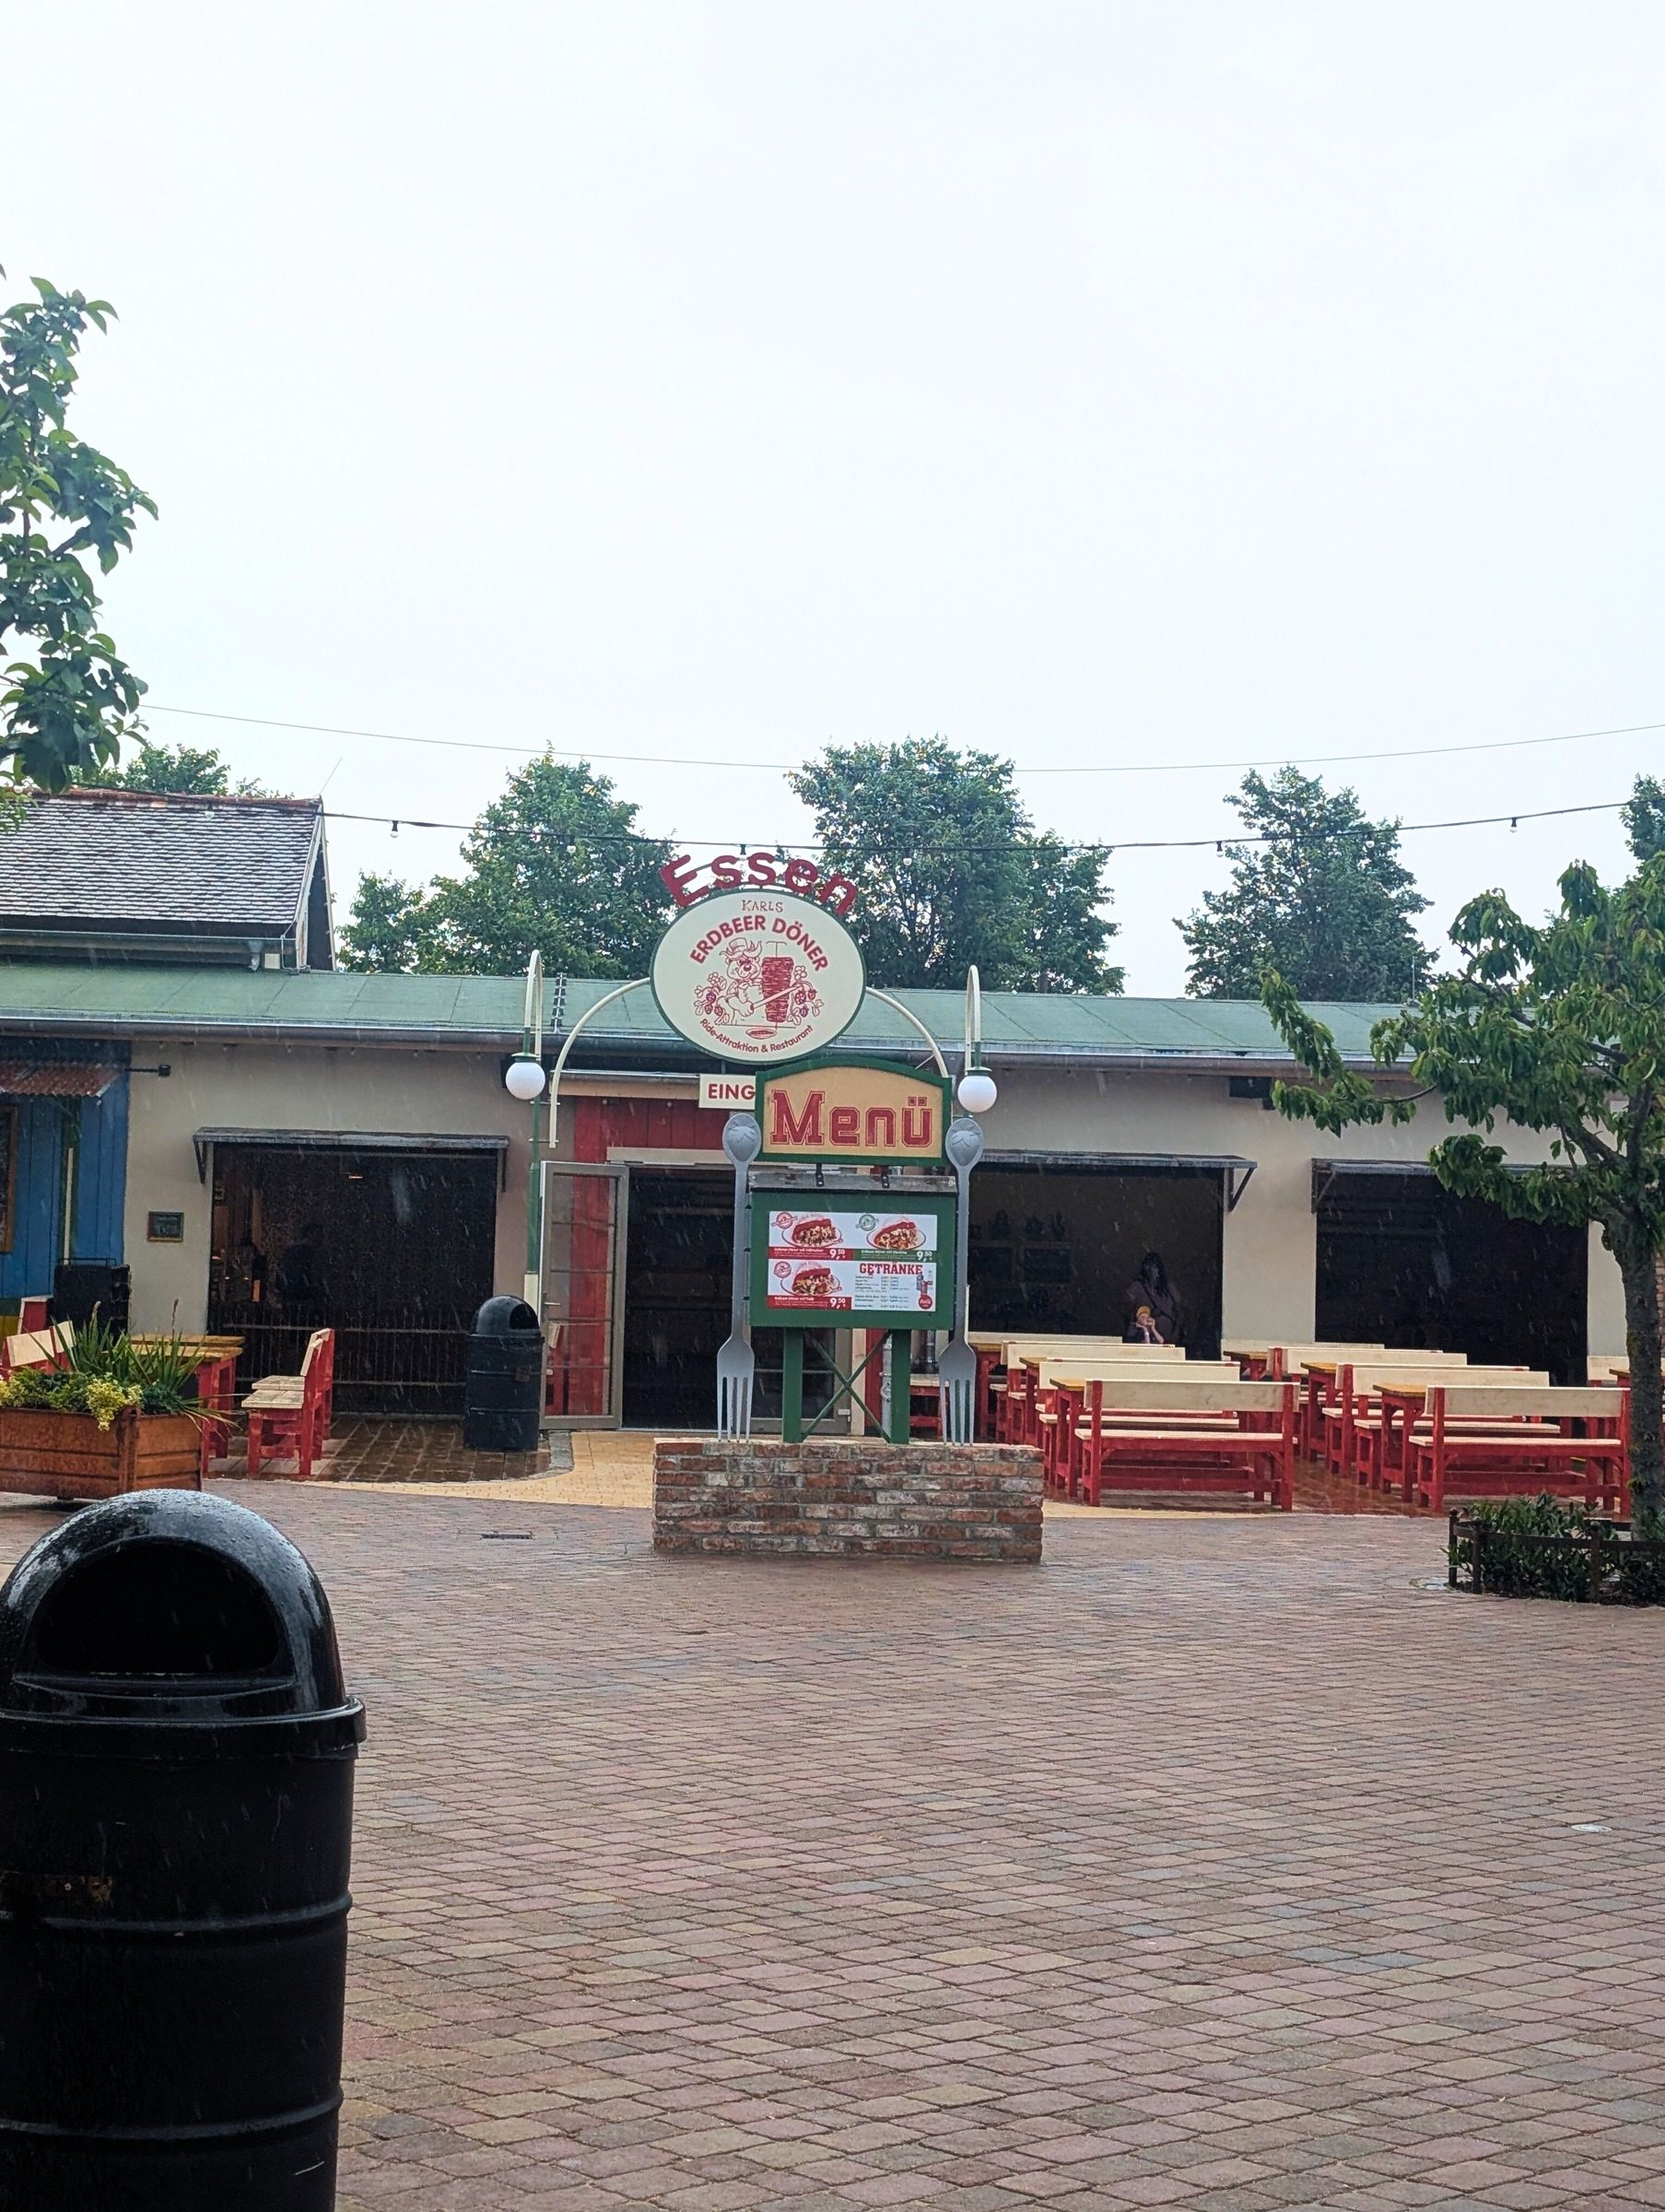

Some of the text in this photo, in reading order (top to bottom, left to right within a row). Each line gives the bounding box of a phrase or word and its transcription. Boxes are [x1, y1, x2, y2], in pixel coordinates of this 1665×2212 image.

[659, 852, 858, 915] Essen
[741, 900, 783, 912] KARLS
[690, 914, 828, 971] ERDBEER DÖNER
[699, 1018, 814, 1053] Ride-Attraktion & Restaurant
[708, 1083, 756, 1100] EING
[770, 1088, 933, 1148] Menü
[860, 1261, 923, 1276] GETRÄNKE
